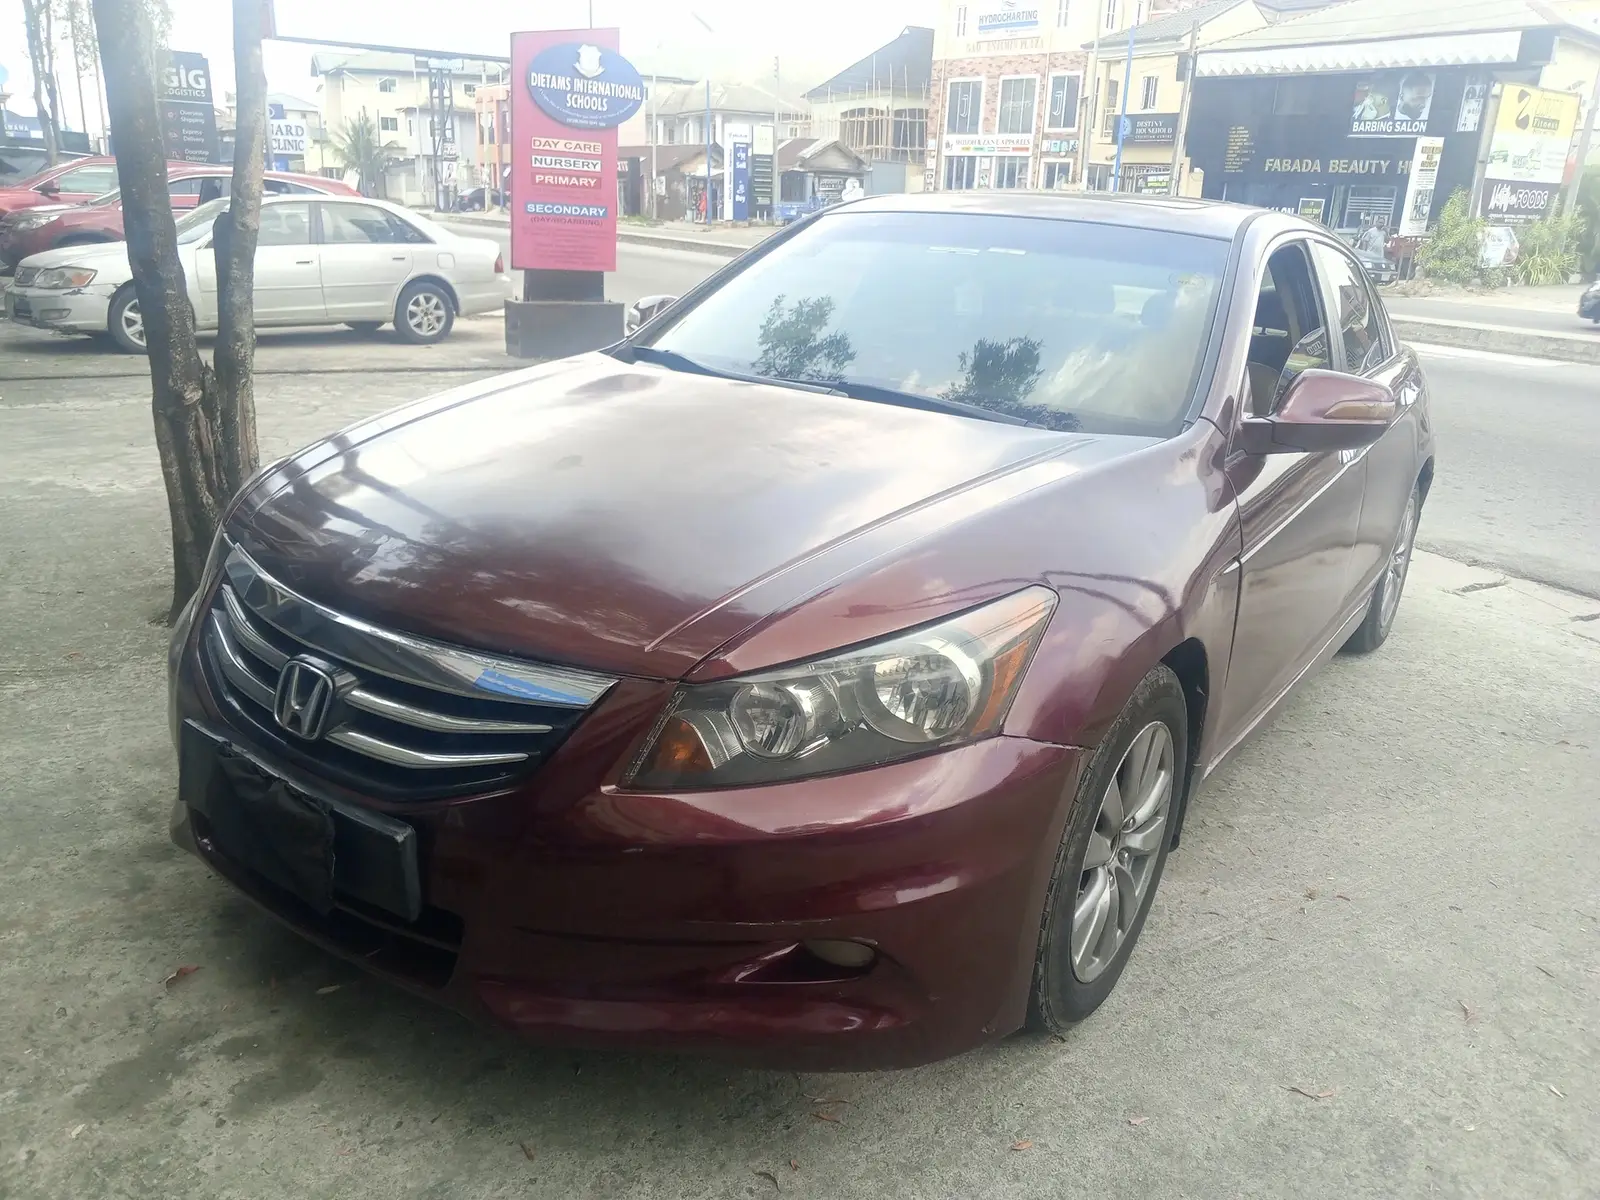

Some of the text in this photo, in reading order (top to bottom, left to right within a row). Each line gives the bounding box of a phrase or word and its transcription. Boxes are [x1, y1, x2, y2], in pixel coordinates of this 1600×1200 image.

[979, 10, 1038, 24] HYDROCHARTING
[164, 64, 207, 90] GIG
[531, 72, 571, 91] DIETAMS
[574, 78, 642, 101] INTERNATIONAL
[566, 93, 608, 112] SCHOOLS
[1135, 127, 1173, 135] HOUSEHOLD
[1136, 120, 1164, 128] DESTINY
[1352, 121, 1427, 133] BARBING SALON
[271, 138, 305, 152] CLINIC
[533, 138, 601, 153] DAY CARE
[533, 156, 599, 170] NURSERY
[1264, 158, 1321, 173] FABADA
[1328, 159, 1391, 175] BEAUTY
[535, 174, 597, 187] PRIMARY
[1513, 189, 1549, 210] FOODS
[527, 203, 606, 217] SECONDARY
